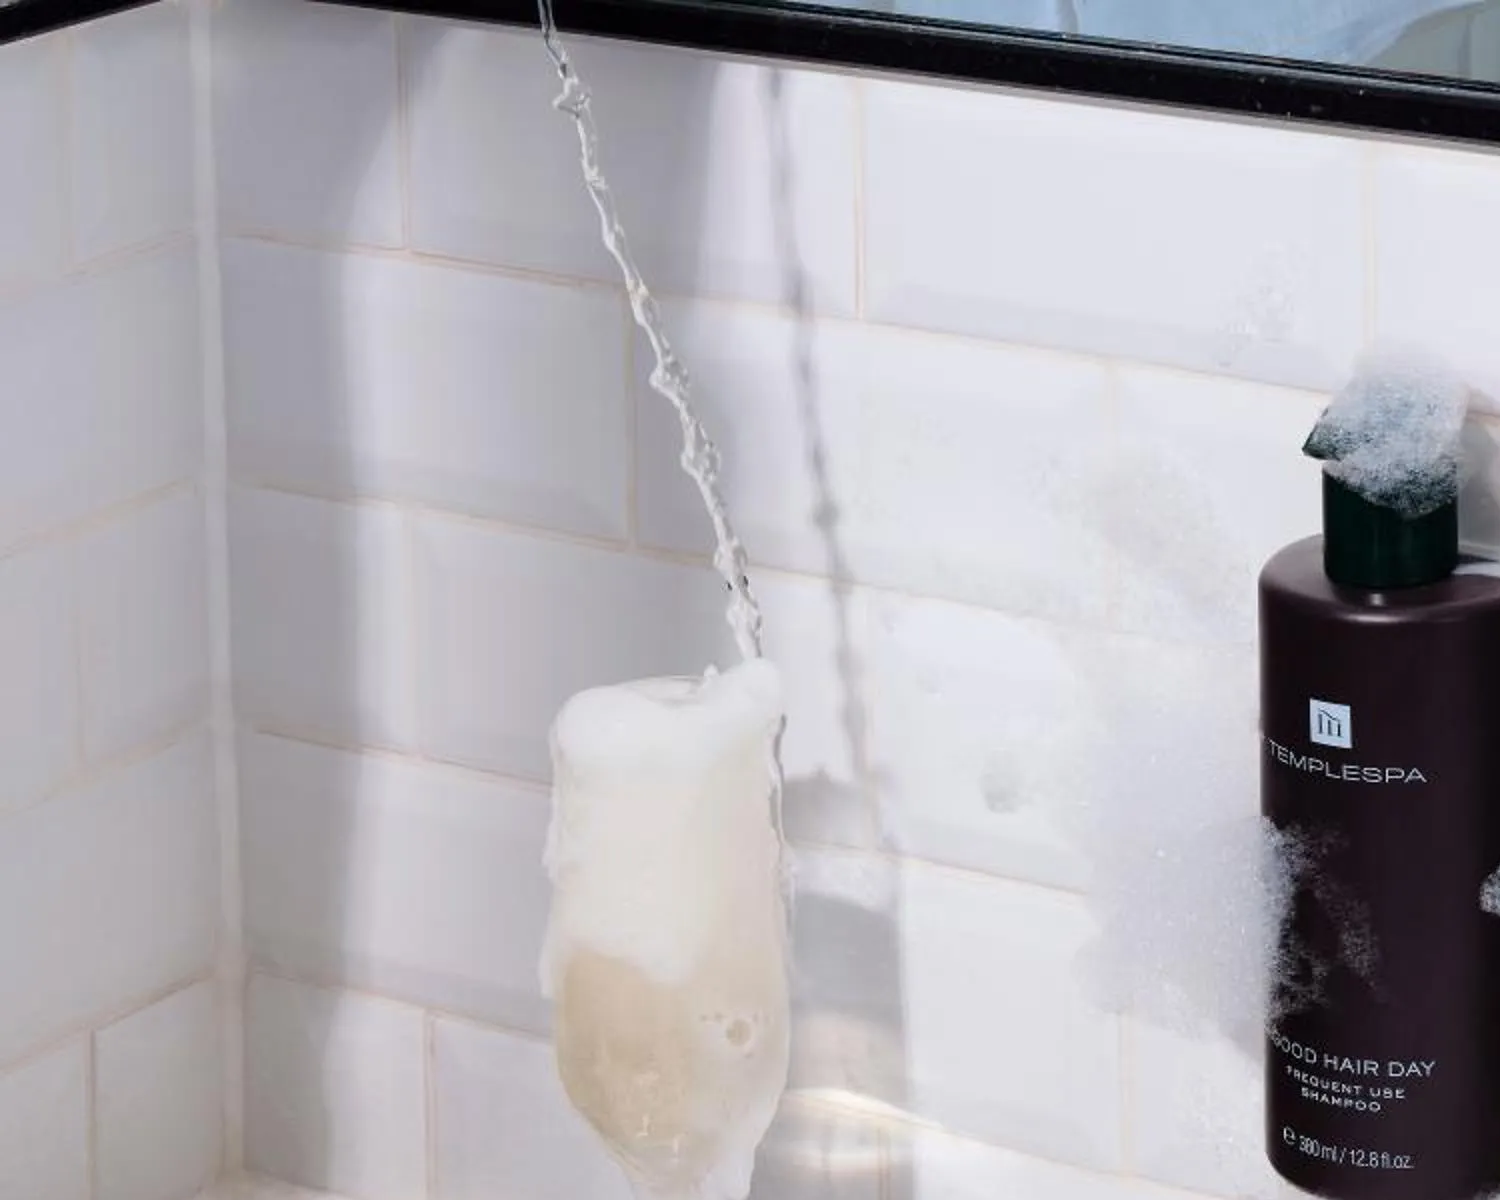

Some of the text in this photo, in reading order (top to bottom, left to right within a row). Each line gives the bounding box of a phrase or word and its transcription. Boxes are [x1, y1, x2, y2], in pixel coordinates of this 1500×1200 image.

[1268, 737, 1428, 783] TEMPLESPA
[1323, 1053, 1380, 1076] HAIR
[1388, 1060, 1436, 1077] DAY
[1284, 1065, 1406, 1100] FREQUENT USE
[1301, 1087, 1381, 1112] SHAMPOO
